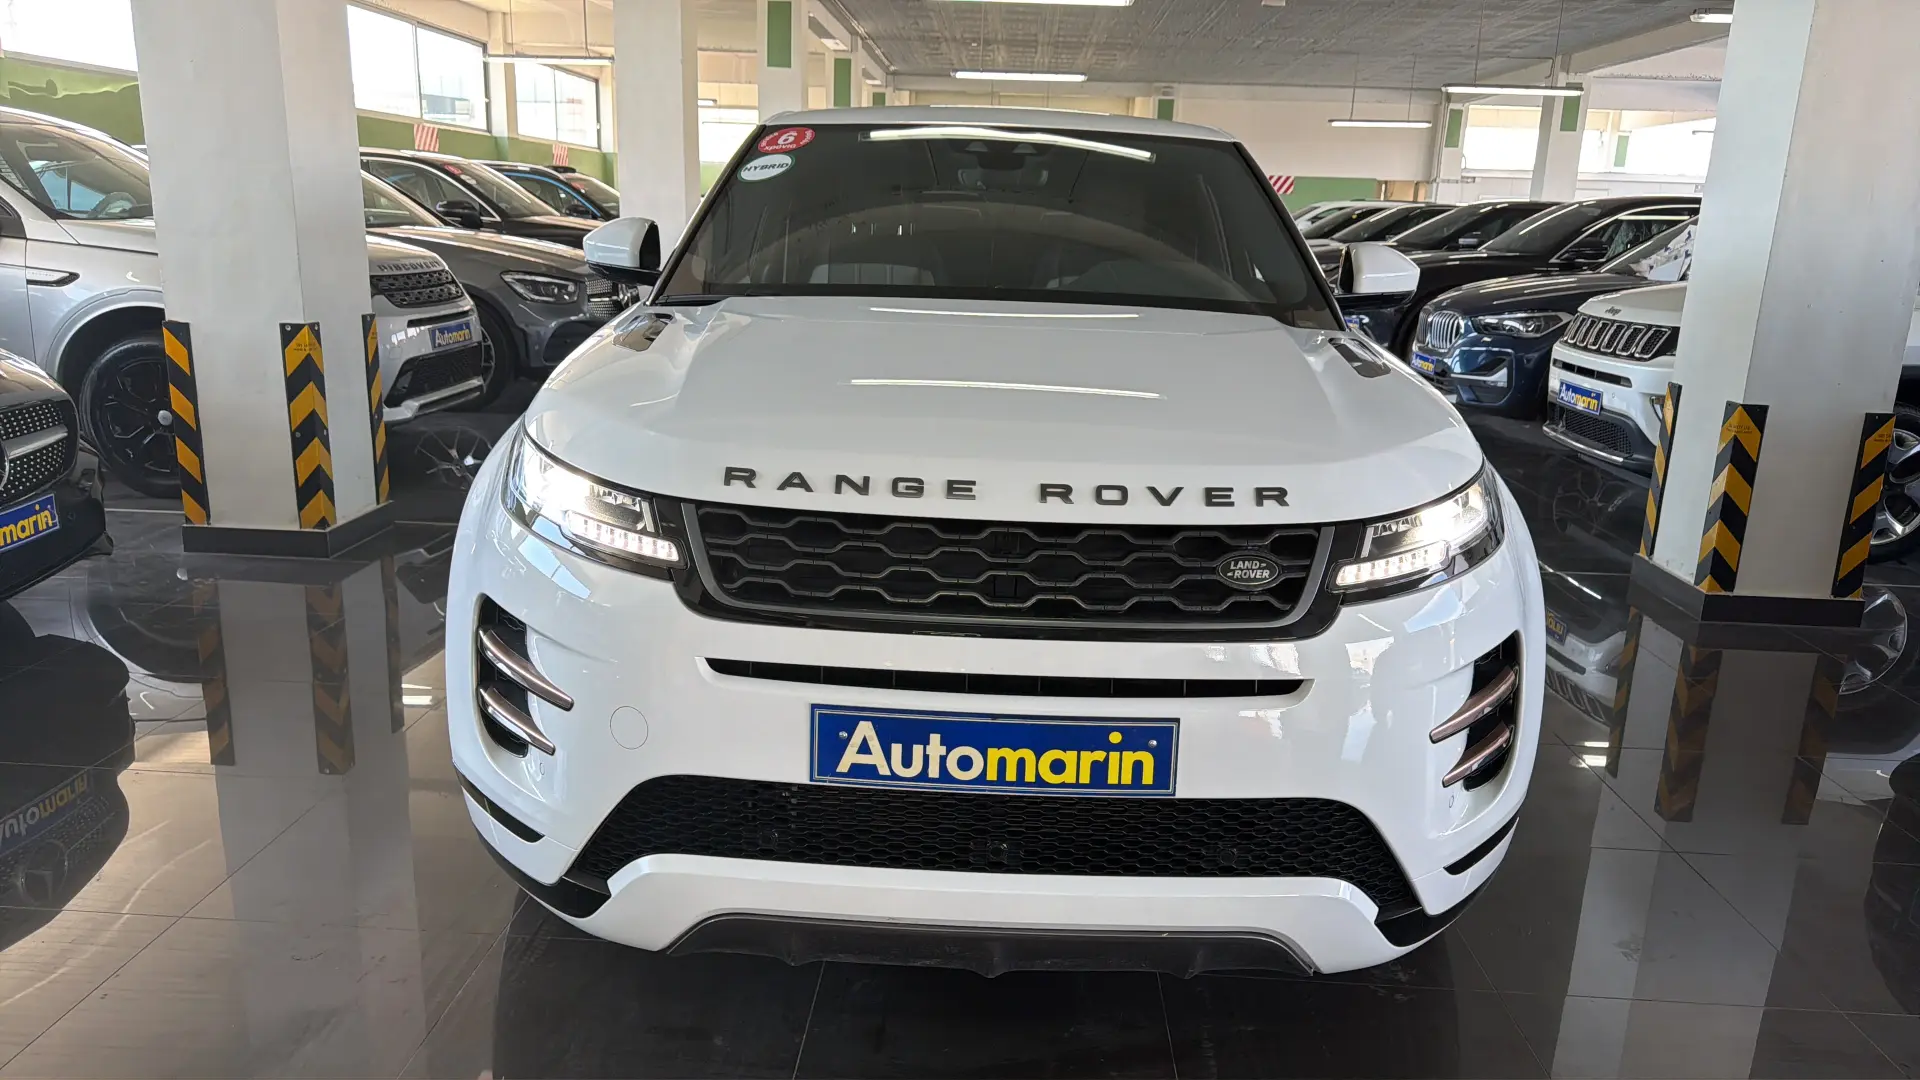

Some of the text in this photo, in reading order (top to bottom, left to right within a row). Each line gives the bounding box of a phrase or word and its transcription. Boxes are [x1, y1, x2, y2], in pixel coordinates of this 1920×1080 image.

[777, 132, 798, 145] 6
[743, 162, 789, 172] HYBRID
[377, 260, 441, 272] DISCOVERY
[435, 324, 471, 347] Automarin
[1560, 384, 1599, 411] Automarin
[723, 466, 1290, 507] RANGE ROVER
[1230, 561, 1260, 570] LAND
[1233, 570, 1270, 579] ROVER
[836, 720, 1154, 784] Automarin
